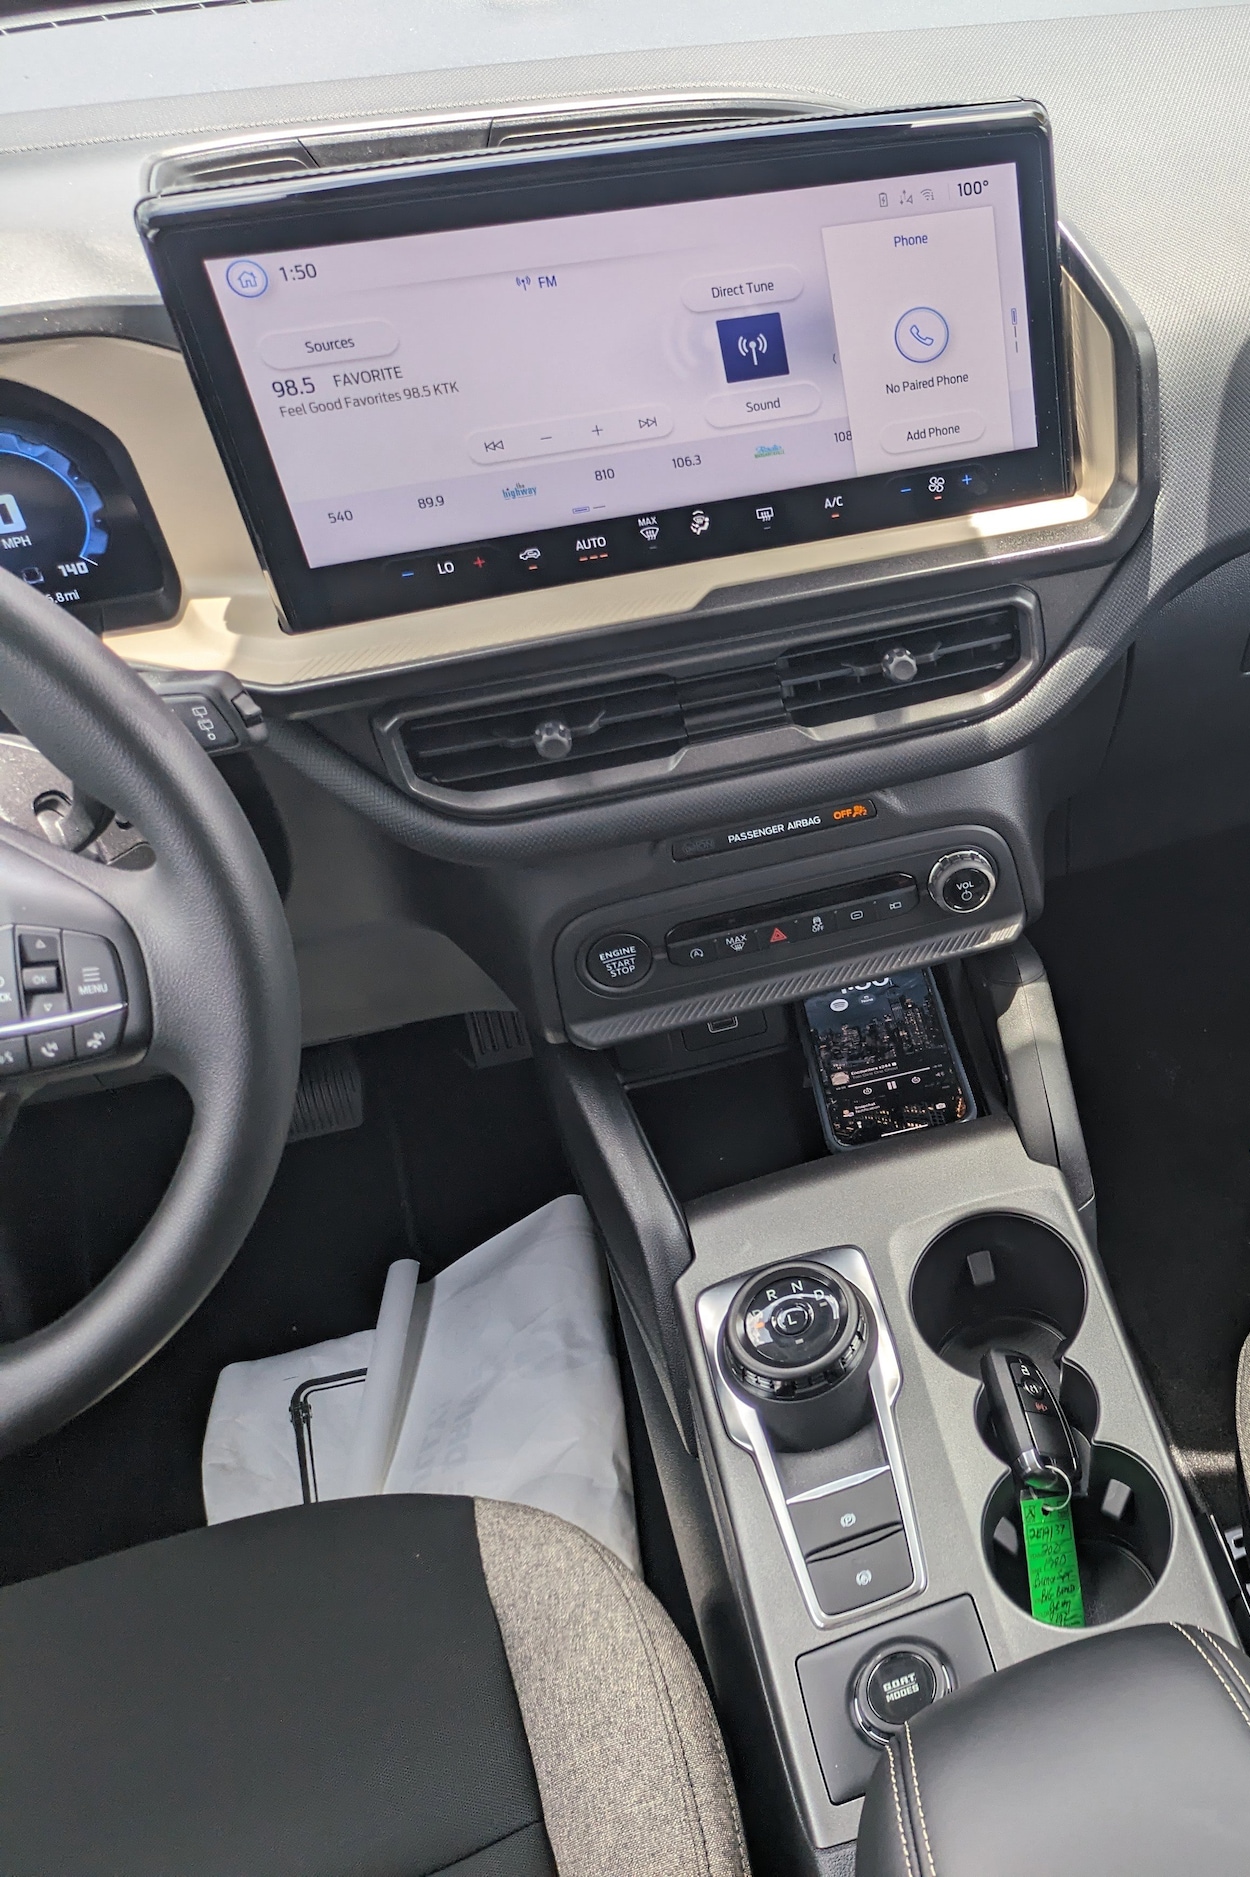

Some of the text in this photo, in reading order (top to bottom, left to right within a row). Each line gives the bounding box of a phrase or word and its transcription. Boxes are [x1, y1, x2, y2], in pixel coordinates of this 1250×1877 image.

[894, 233, 928, 247] Phone
[279, 263, 317, 282] 1:50
[538, 275, 557, 290] FM
[712, 280, 774, 298] Direct Tune
[305, 335, 355, 353] Sources
[272, 366, 403, 398] 98.5 FAVORITE
[886, 372, 968, 394] No Paired Phone
[279, 382, 459, 418] Feel Good Favorites 98.5 KTK
[746, 398, 780, 412] Sound
[906, 424, 960, 441] Add Phone
[672, 455, 702, 468] 106.3
[594, 468, 614, 481] 810
[502, 487, 537, 499] highway
[418, 496, 444, 510] 89.9
[824, 496, 843, 508] A/C
[328, 510, 353, 524] 540
[638, 516, 658, 528] MAX
[1, 535, 32, 550] MPH
[576, 536, 606, 550] AUTO
[58, 562, 89, 577] 140
[438, 562, 454, 574] LO
[728, 824, 784, 843] PASSENGER
[787, 816, 821, 831] AIRBAG
[833, 808, 852, 820] OFF
[956, 881, 974, 890] VOL
[812, 924, 824, 932] OFF
[726, 934, 748, 946] MAX
[600, 946, 636, 961] ENGINE
[606, 958, 636, 972] START
[610, 965, 636, 978] STOP
[32, 976, 48, 984] OK
[78, 984, 108, 995] MENU
[790, 1280, 804, 1292] N
[766, 1290, 778, 1301] R
[814, 1290, 824, 1300] D
[788, 1314, 797, 1325] L
[886, 1683, 919, 1702] MODES
